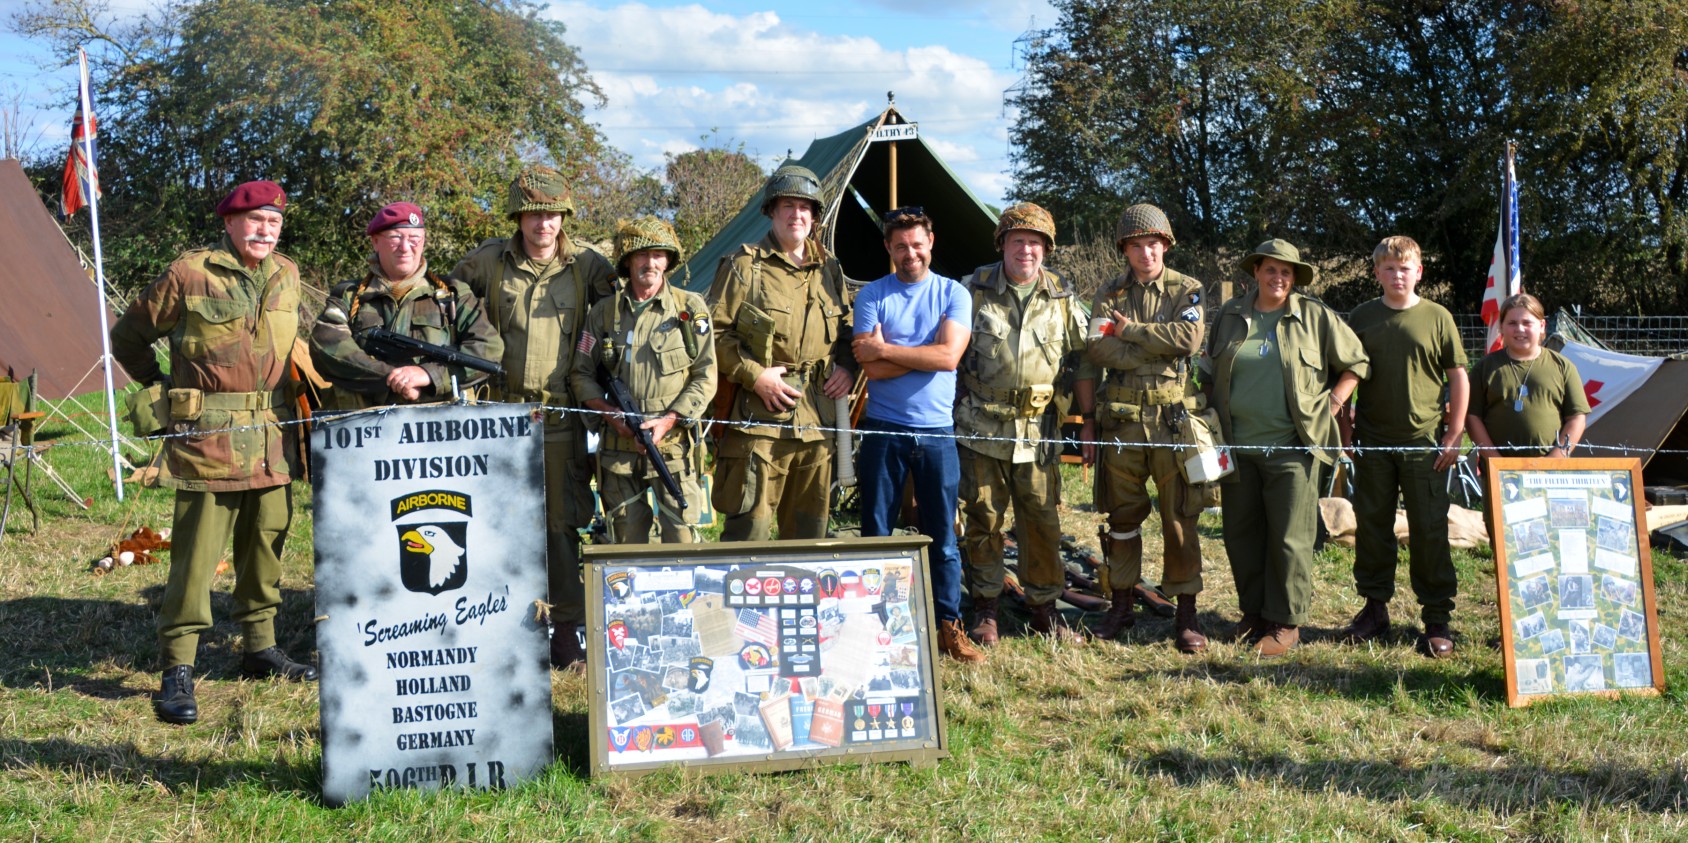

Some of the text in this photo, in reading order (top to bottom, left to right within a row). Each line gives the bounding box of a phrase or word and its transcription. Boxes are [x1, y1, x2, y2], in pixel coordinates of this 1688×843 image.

[872, 128, 901, 137] ILTHY
[323, 414, 532, 449] 101ST AIRBORNE
[374, 454, 489, 481] DIVISION
[396, 493, 467, 515] AIRBORNE
[386, 646, 478, 669] NORMANDY
[395, 674, 471, 696] HOLLAND
[392, 701, 478, 724] BASTOGNE
[396, 728, 476, 751] GERMANY
[369, 765, 437, 792] 506TH
